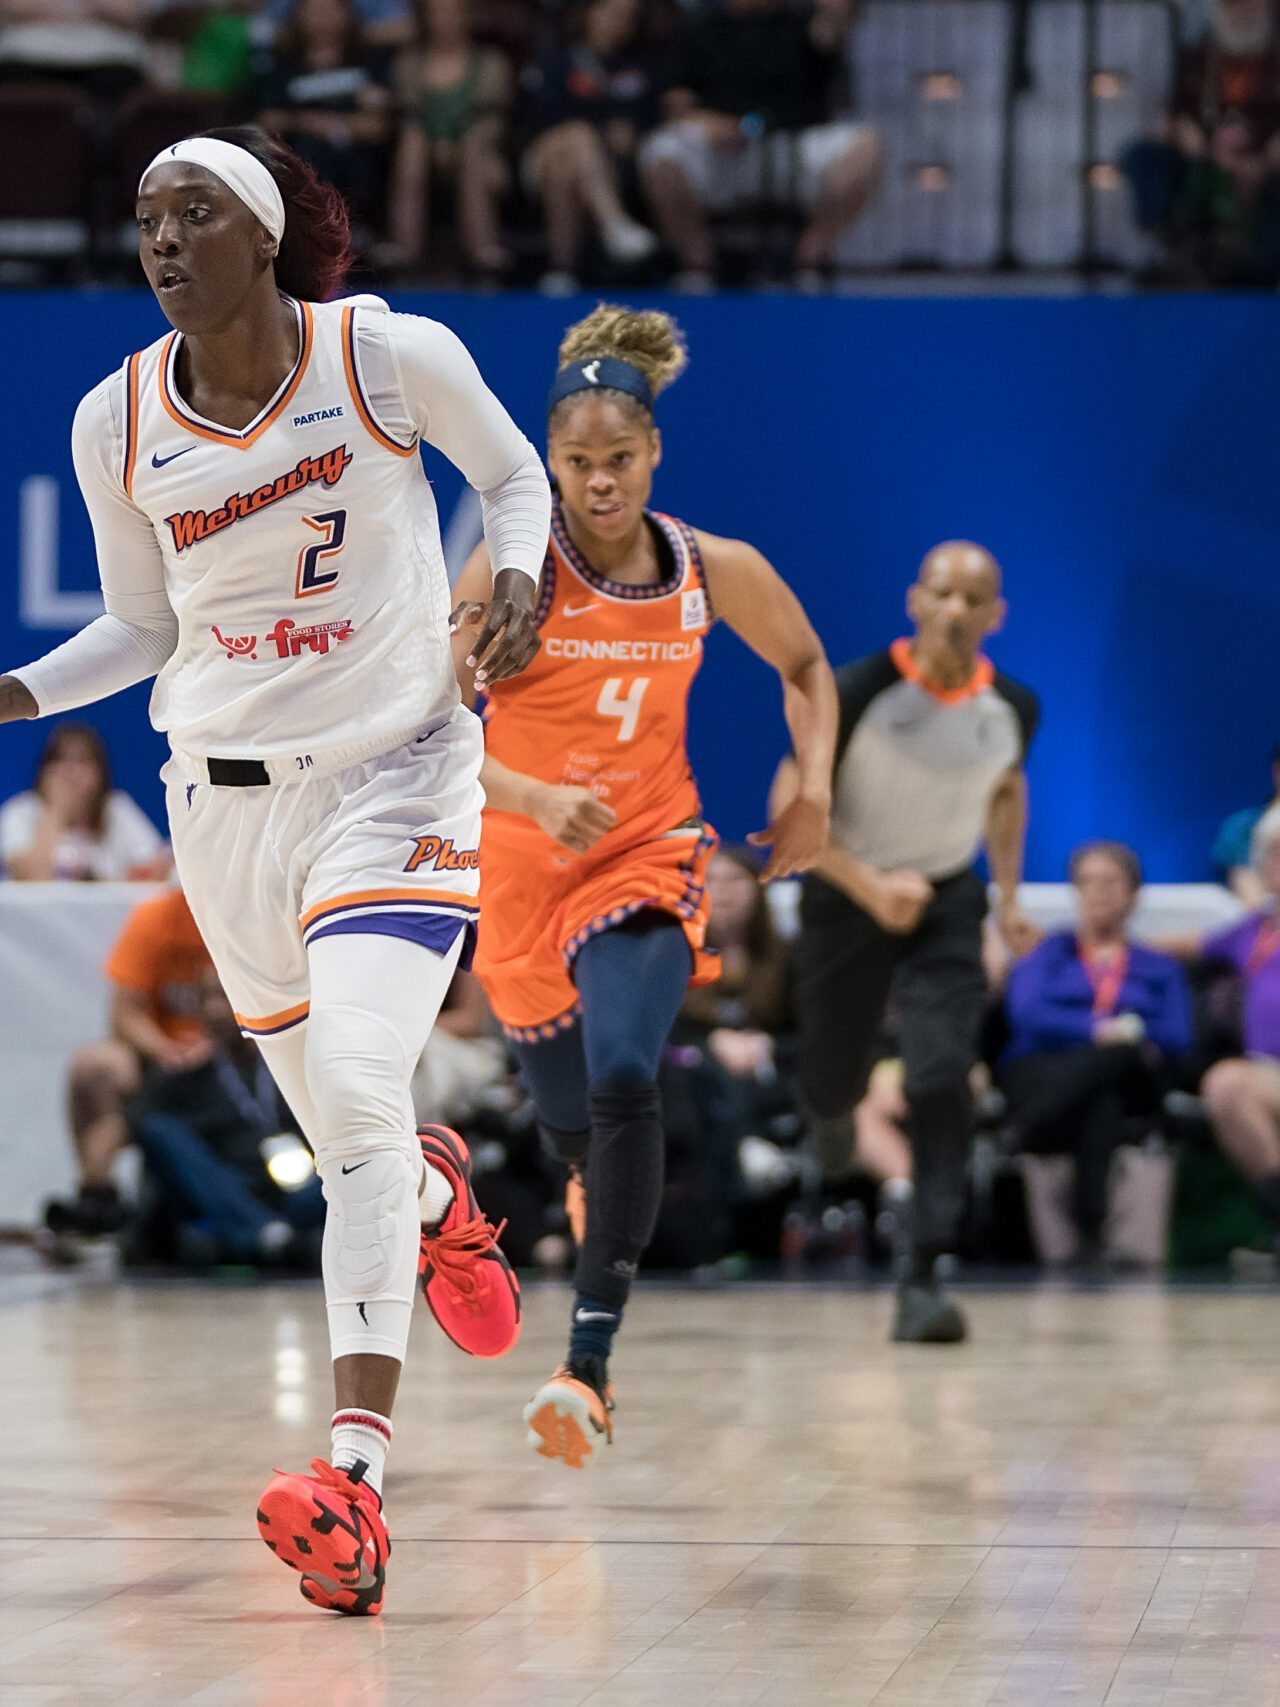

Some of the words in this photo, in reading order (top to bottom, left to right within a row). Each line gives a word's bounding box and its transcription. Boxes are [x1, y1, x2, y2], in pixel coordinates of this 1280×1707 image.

[293, 406, 344, 427] PARTAKE
[164, 443, 354, 553] Mercury
[294, 508, 348, 600] 2
[265, 618, 355, 659] fry's
[287, 627, 313, 638] FOOD
[314, 619, 349, 633] STORES
[596, 677, 651, 741] 4
[402, 834, 480, 873] Phoe
